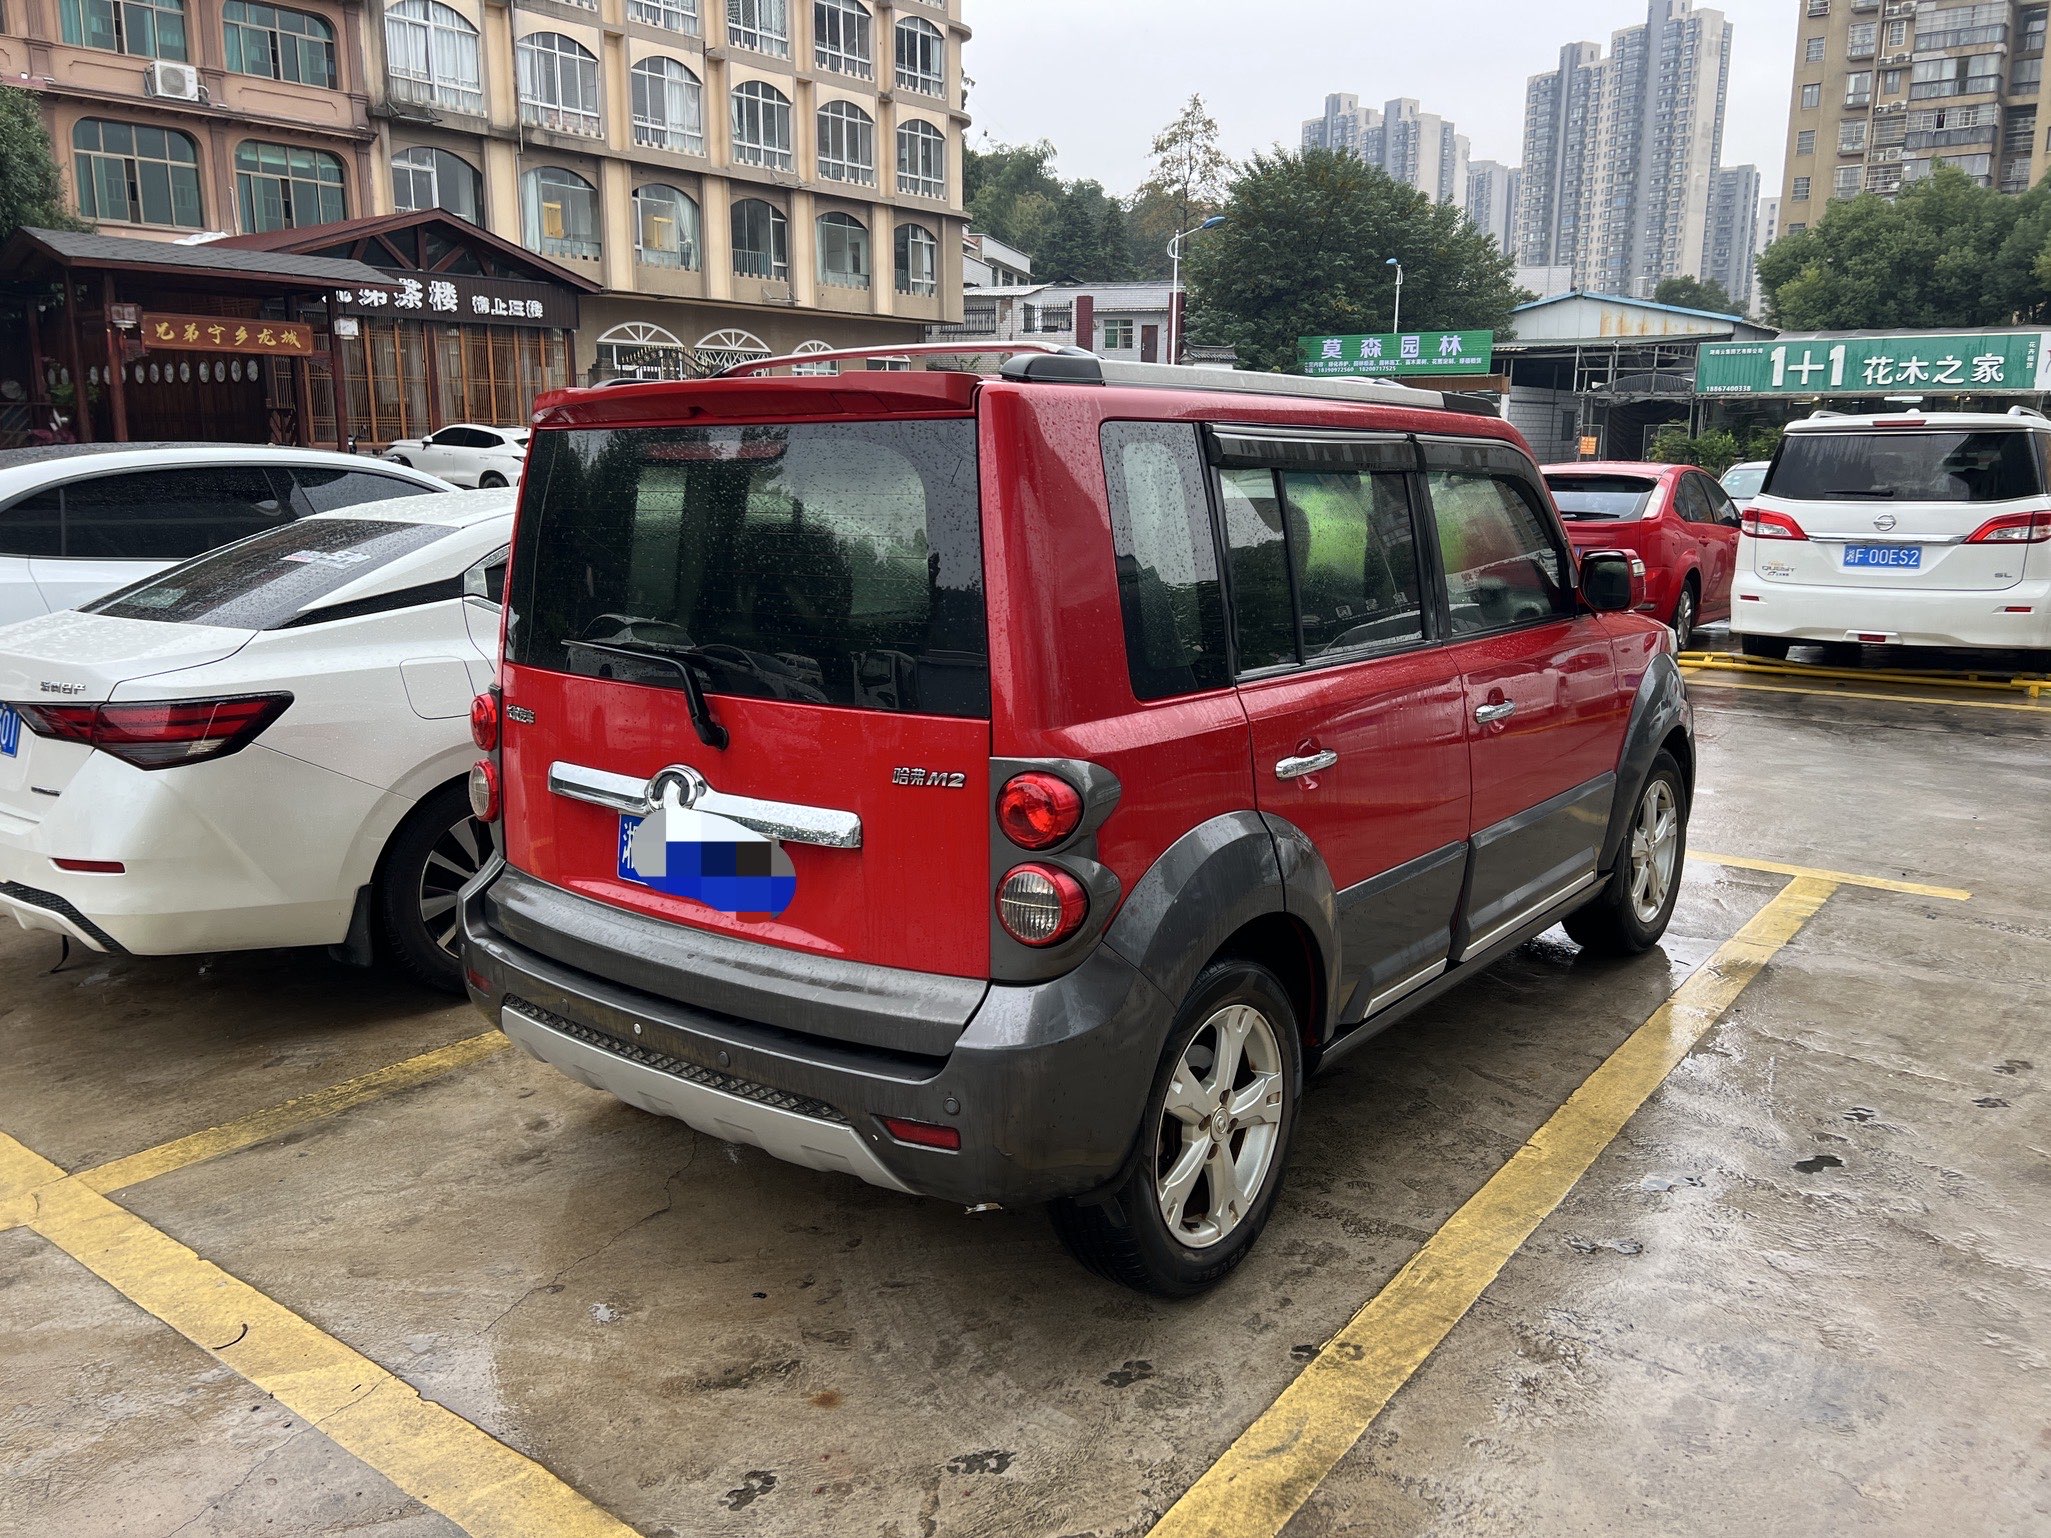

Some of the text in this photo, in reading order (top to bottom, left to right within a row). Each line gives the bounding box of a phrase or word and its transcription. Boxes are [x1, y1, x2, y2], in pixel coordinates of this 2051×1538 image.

[1321, 335, 1462, 359] 莫森园林
[1771, 345, 1846, 386] 1+1
[1862, 353, 2005, 385] 花木之家
